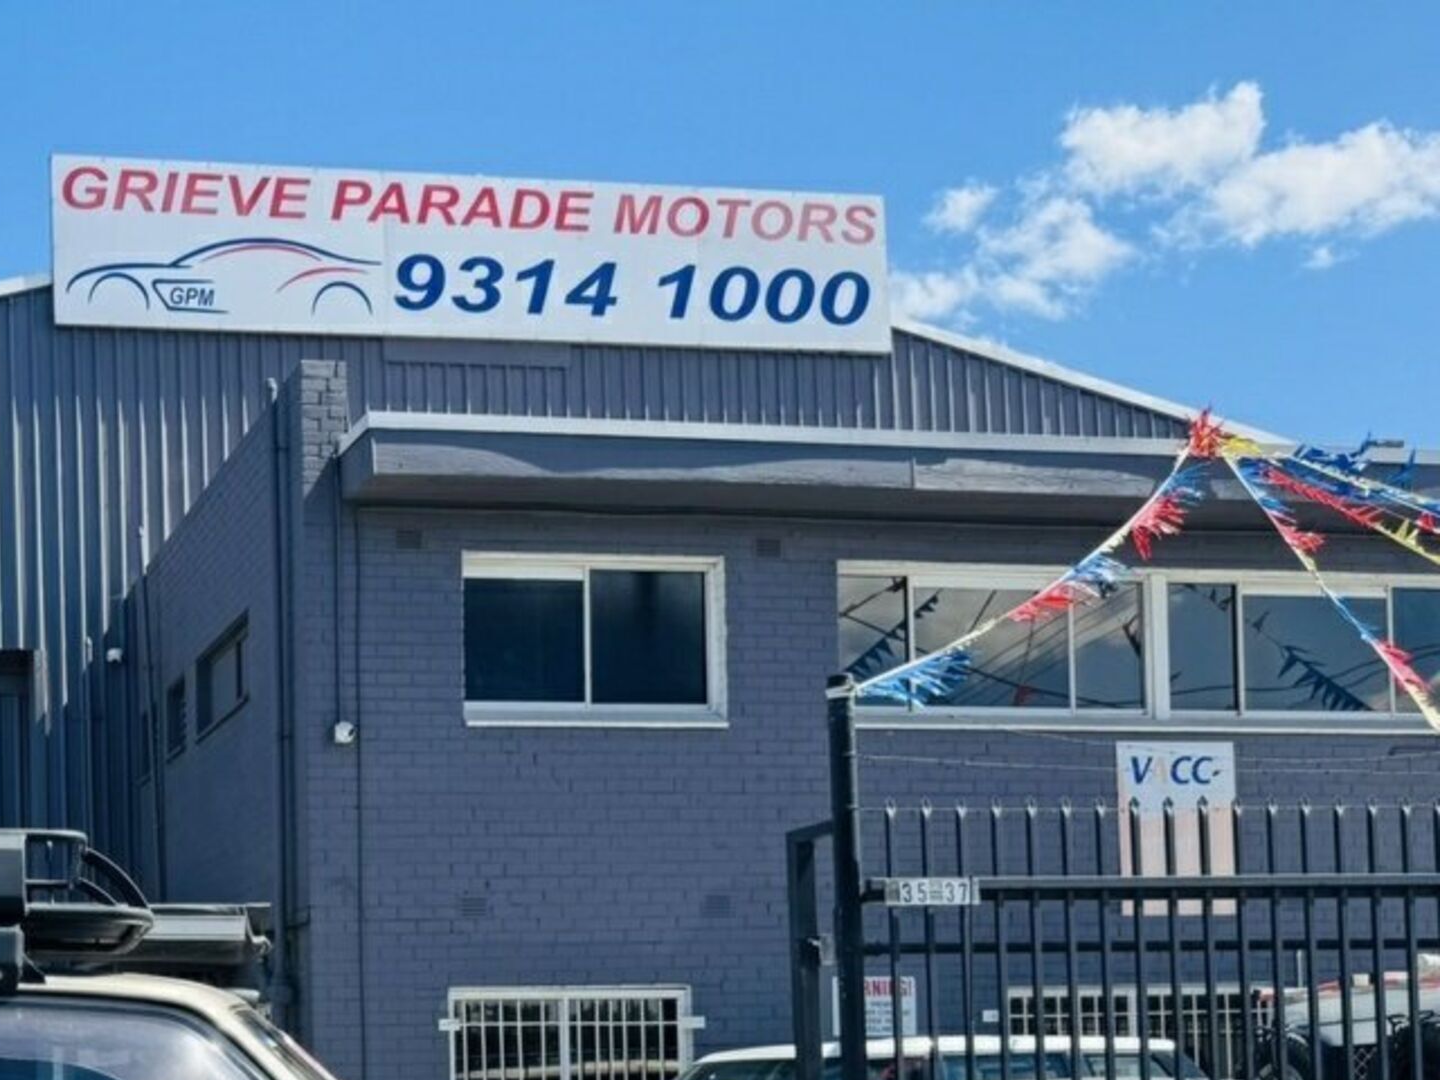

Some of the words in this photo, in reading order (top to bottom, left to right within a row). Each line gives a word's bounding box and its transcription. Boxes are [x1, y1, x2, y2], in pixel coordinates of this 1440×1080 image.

[62, 167, 311, 219] GRIEVE
[331, 180, 594, 232] PARADE
[613, 194, 877, 245] MOTORS
[169, 287, 215, 306] GPM
[394, 254, 618, 317] 9314
[658, 264, 871, 325] 1000
